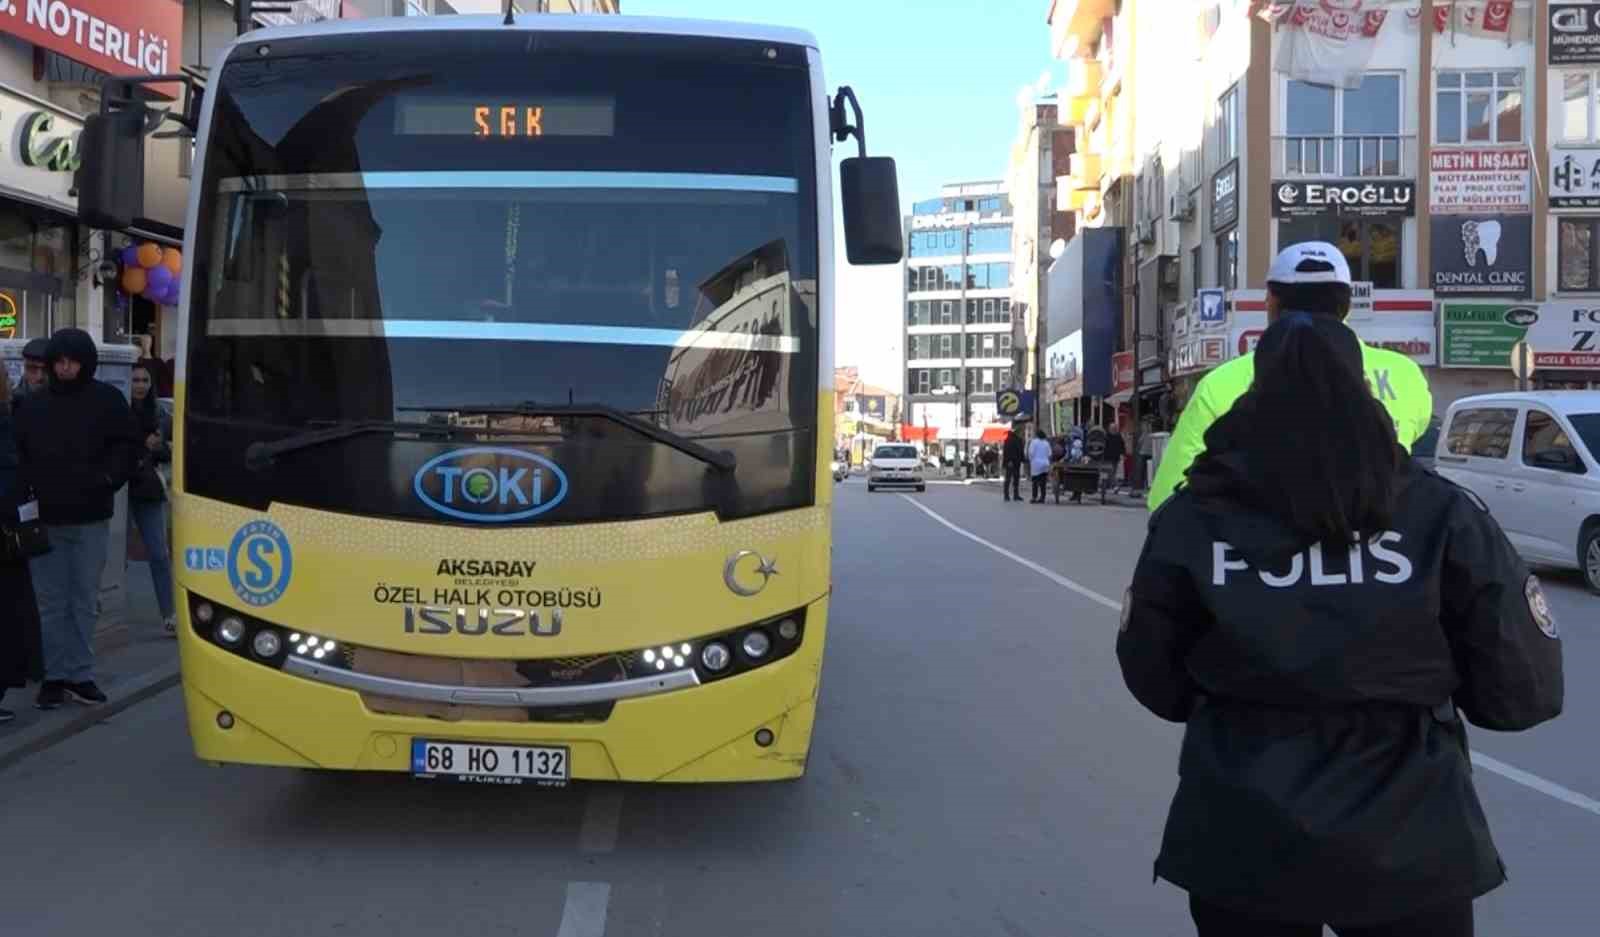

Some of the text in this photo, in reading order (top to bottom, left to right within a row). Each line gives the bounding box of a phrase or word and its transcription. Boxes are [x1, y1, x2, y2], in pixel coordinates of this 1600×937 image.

[1305, 183, 1411, 204] EROĞLU
[1435, 271, 1483, 284] DENTAL
[436, 559, 537, 577] AKSARAY
[373, 582, 602, 608] ÖZEL HALK OTOBÜSÜ
[404, 607, 563, 637] ISUZU
[427, 746, 453, 770] 68
[512, 750, 564, 777] 1132
